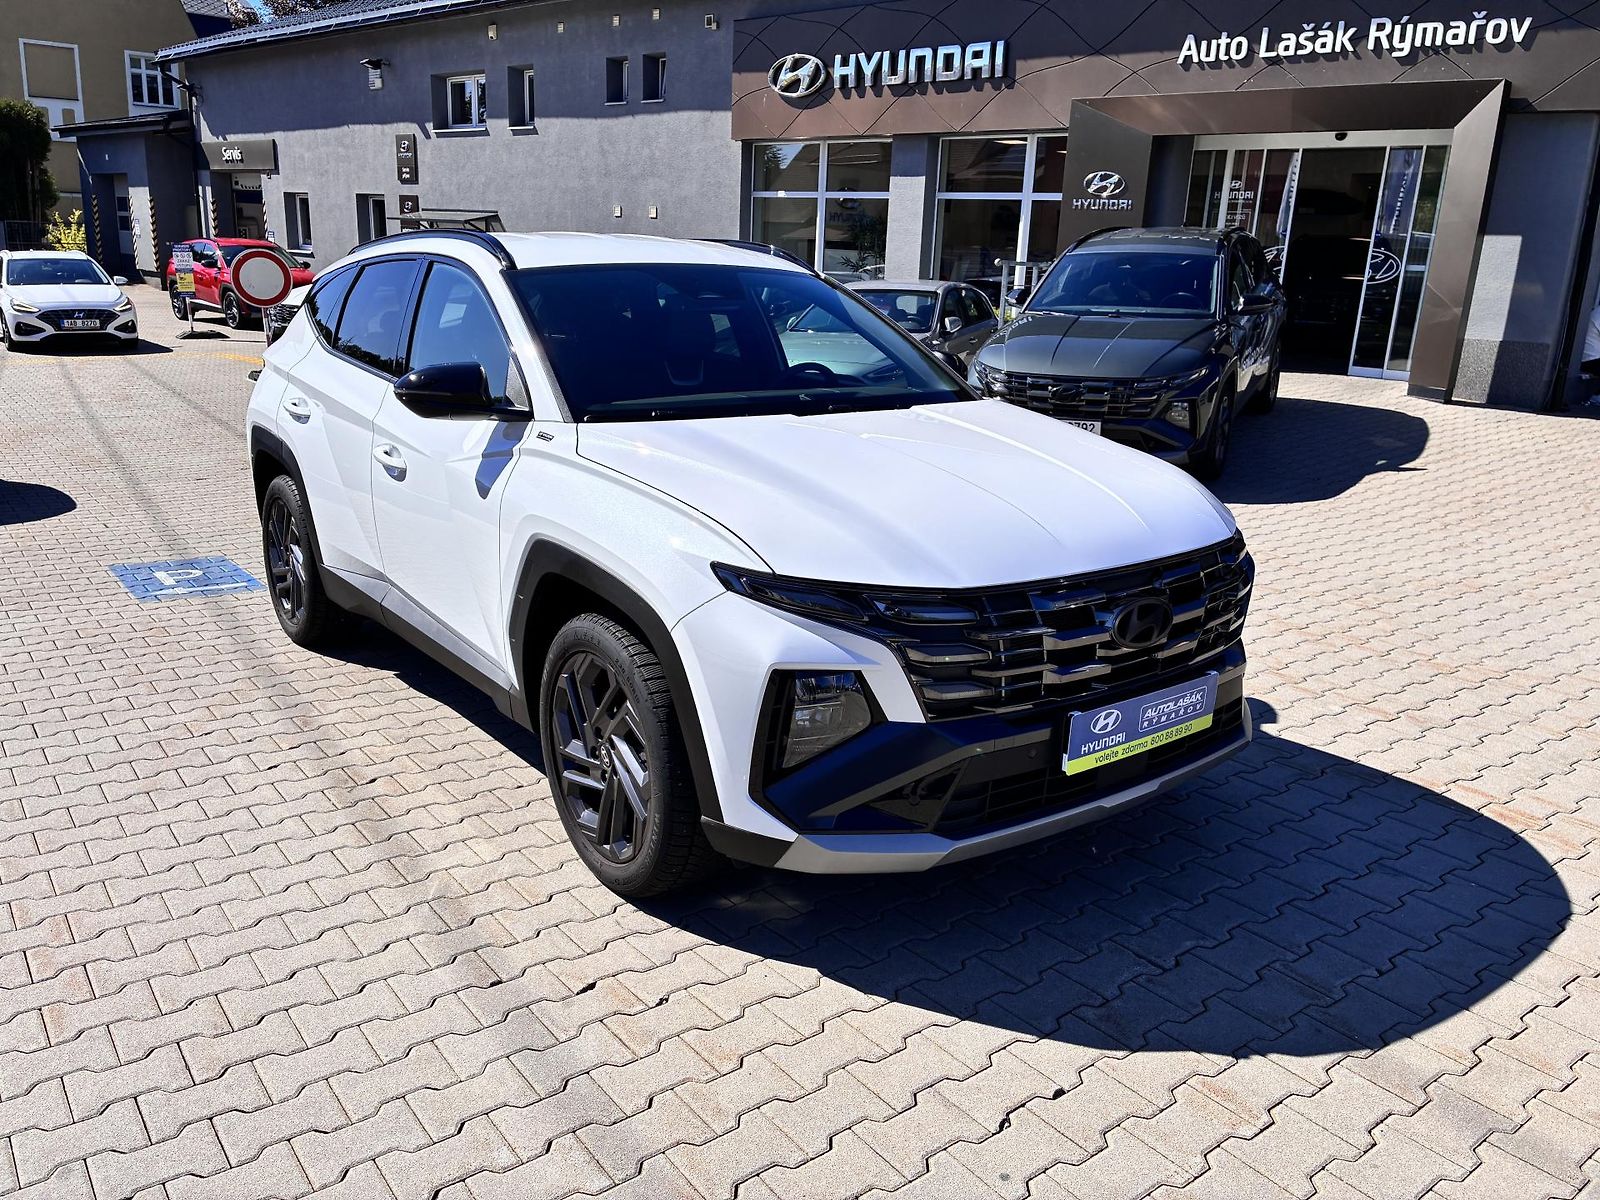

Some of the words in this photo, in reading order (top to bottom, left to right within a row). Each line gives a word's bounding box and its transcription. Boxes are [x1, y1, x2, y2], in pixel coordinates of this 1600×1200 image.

[1177, 31, 1249, 64] Auto
[1259, 20, 1358, 58] Lašák
[1367, 10, 1533, 58] Rýmařov
[833, 40, 1005, 89] HYUNDAI
[221, 146, 242, 160] Servis
[1072, 198, 1132, 210] HYUNDAI
[1214, 191, 1254, 199] HNDAI
[1068, 421, 1096, 433] 792
[1142, 702, 1203, 728] RÝMAŘOV
[1143, 690, 1204, 719] AUTOLAŠÁK
[1081, 732, 1126, 755] HYUNDAI
[1094, 749, 1119, 764] volejte
[1121, 740, 1148, 756] zdarma
